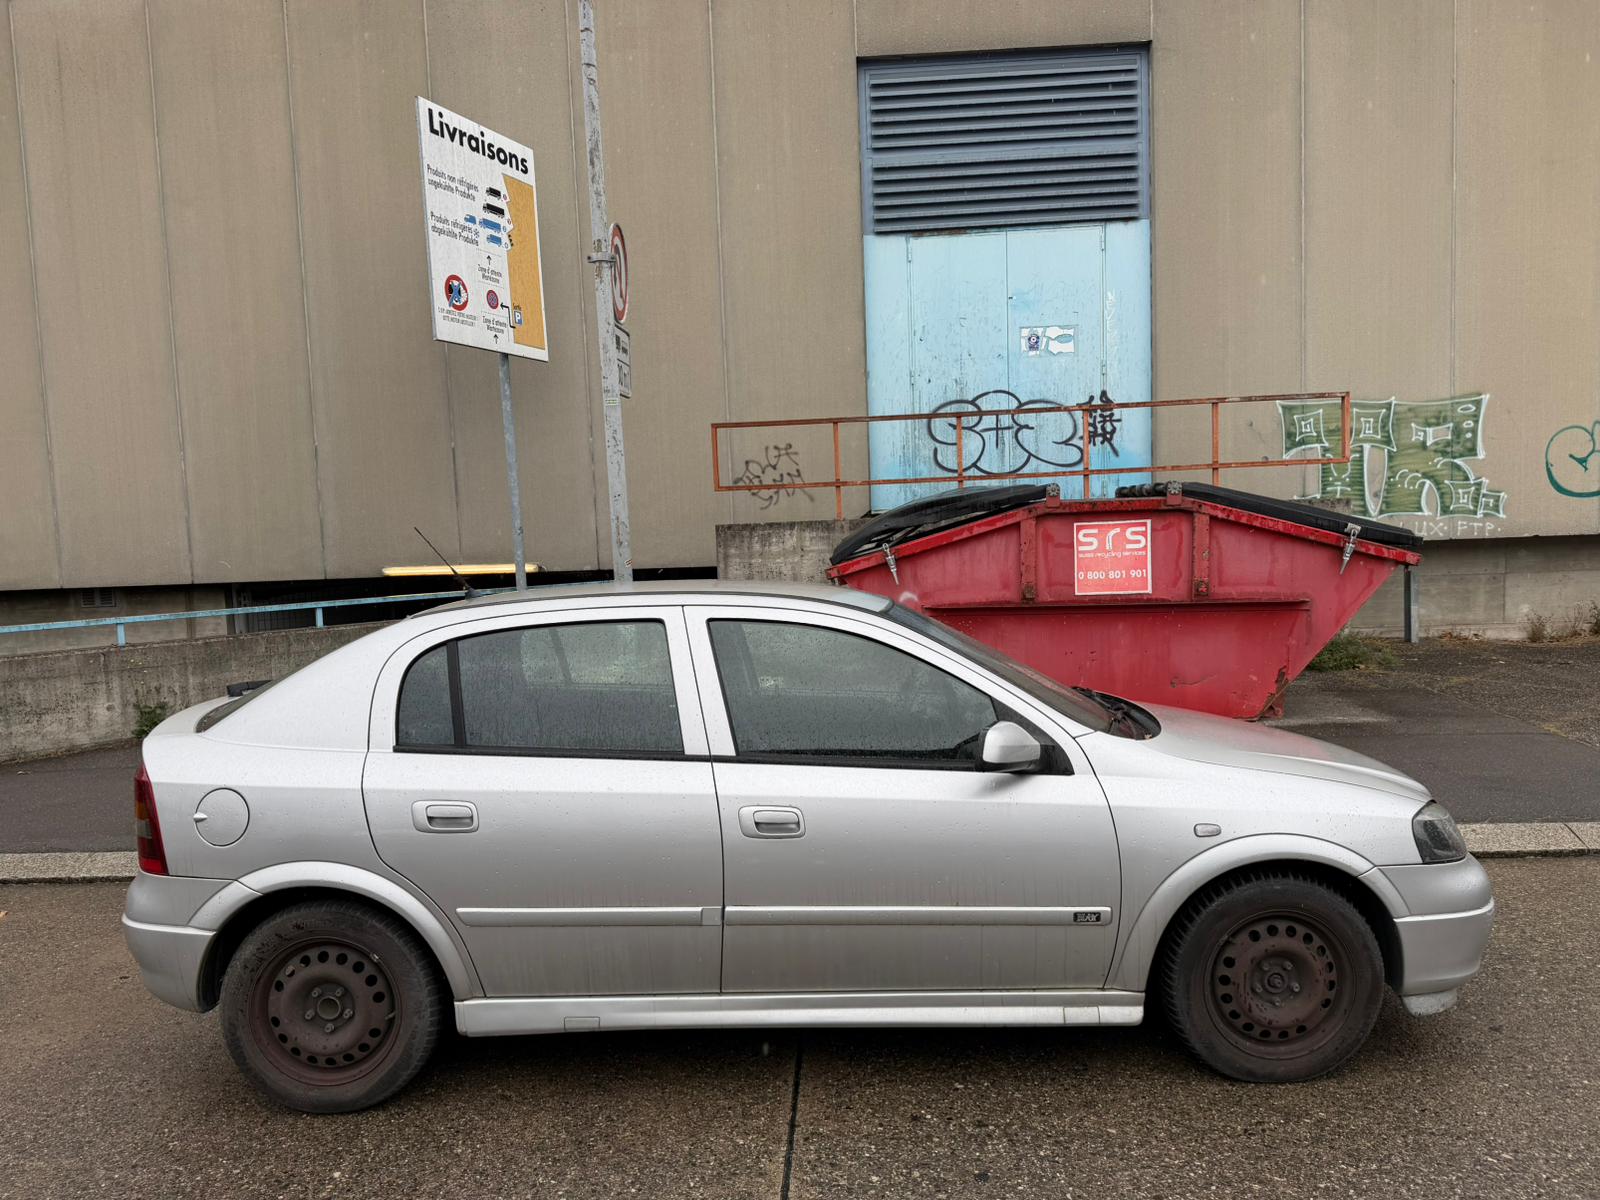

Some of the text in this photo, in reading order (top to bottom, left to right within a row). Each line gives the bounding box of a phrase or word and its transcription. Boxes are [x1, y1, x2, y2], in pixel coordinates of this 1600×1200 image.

[428, 108, 529, 175] Livraisons
[427, 163, 447, 180] Produits
[447, 174, 456, 184] non
[455, 186, 476, 202] Produkte
[1078, 569, 1147, 580] 0 800 801 901
